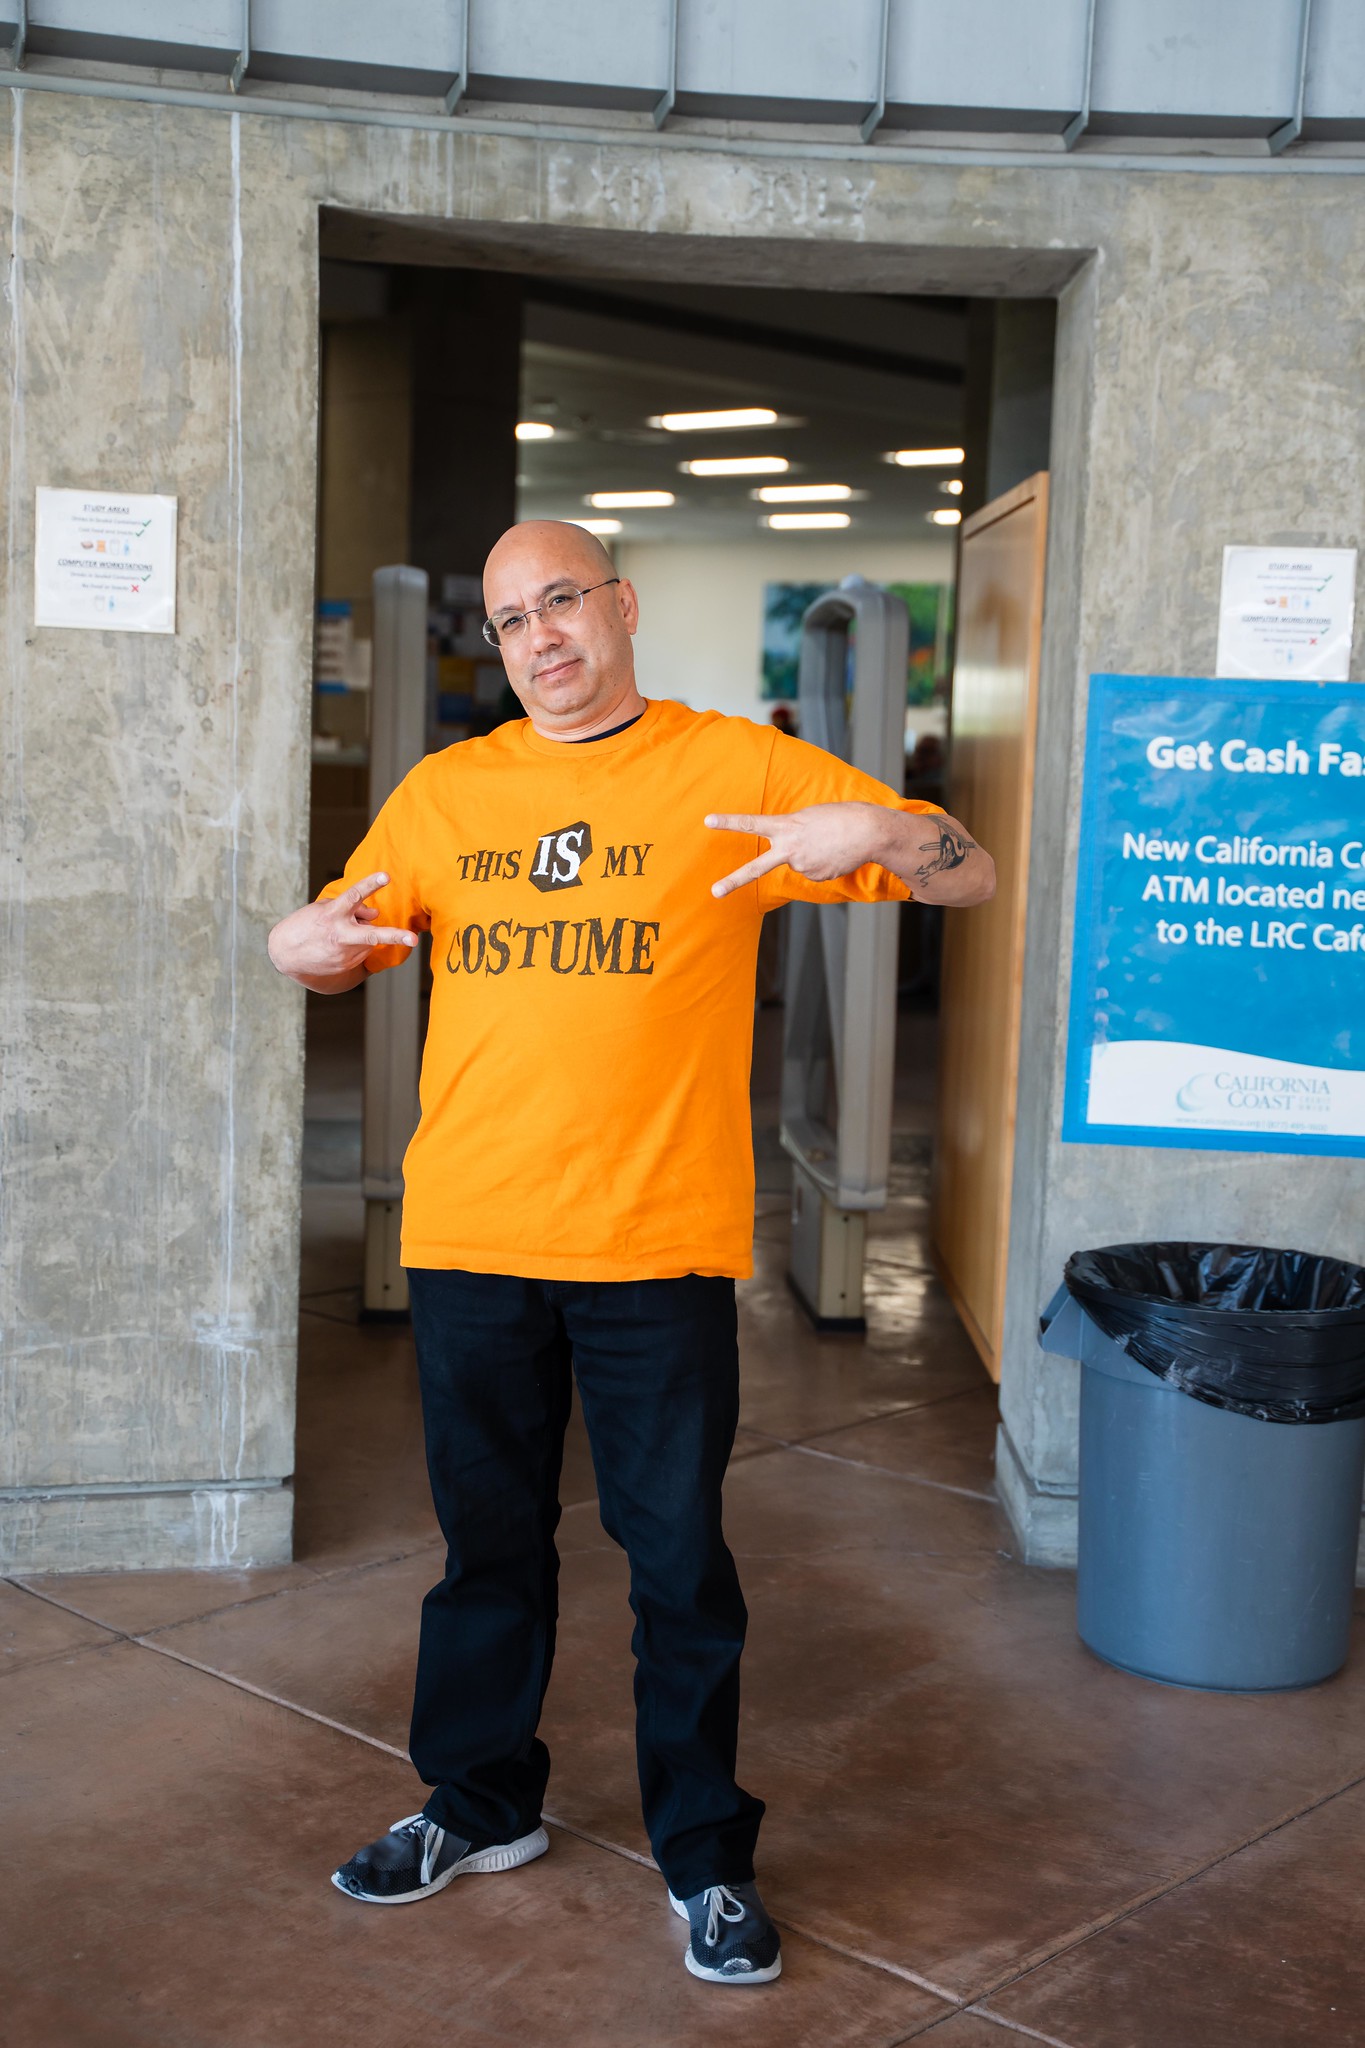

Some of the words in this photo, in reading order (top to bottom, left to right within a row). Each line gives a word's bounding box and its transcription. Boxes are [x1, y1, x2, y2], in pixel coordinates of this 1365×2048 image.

[1146, 736, 1214, 772] Get
[1219, 738, 1310, 776] Cash
[1318, 742, 1365, 777] Fa
[456, 849, 523, 883] THIS
[532, 829, 585, 884] IS
[600, 843, 654, 878] MY
[1122, 832, 1190, 862] New
[1194, 834, 1334, 869] California
[1340, 841, 1365, 870] C
[1141, 874, 1210, 904] ATM
[1216, 875, 1325, 909] located
[446, 917, 661, 978] COSTUME
[1156, 918, 1188, 944] to
[1194, 917, 1243, 947] the
[1250, 920, 1307, 950] LRC
[1312, 923, 1365, 952] Caf
[1214, 1071, 1331, 1096] CALIFORNIA
[1228, 1090, 1296, 1111] COAST
